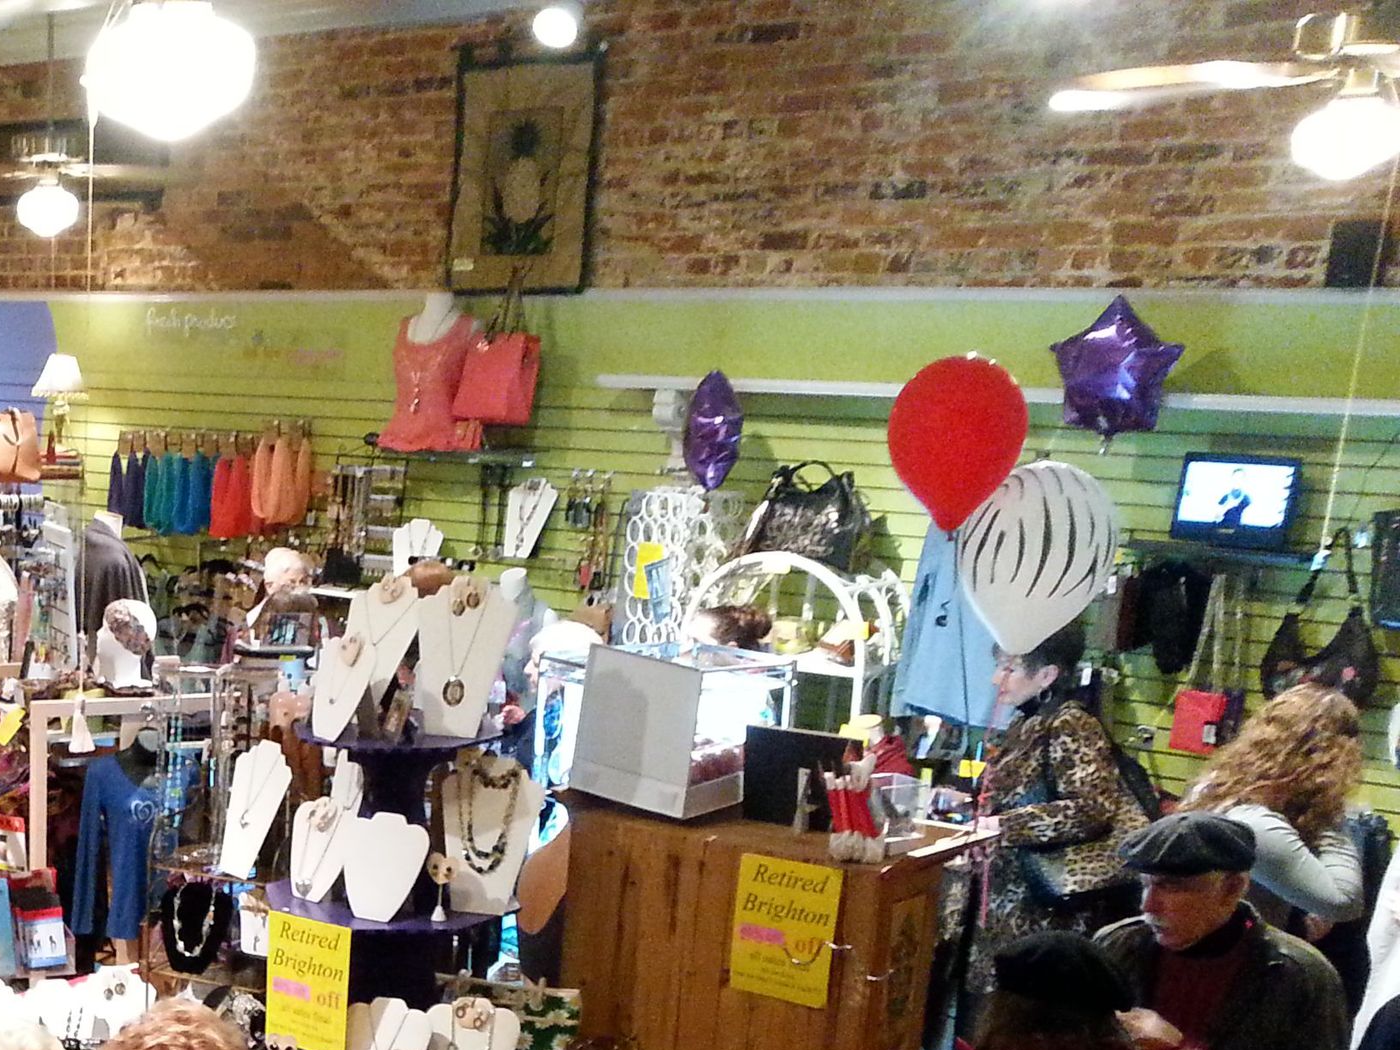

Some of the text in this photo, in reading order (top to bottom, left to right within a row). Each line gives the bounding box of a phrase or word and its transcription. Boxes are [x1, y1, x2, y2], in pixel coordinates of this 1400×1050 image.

[752, 863, 830, 894] Retired
[743, 893, 831, 926] Brighton
[280, 921, 341, 951] Retired
[273, 948, 344, 982] Brighton
[316, 991, 342, 1010] off
